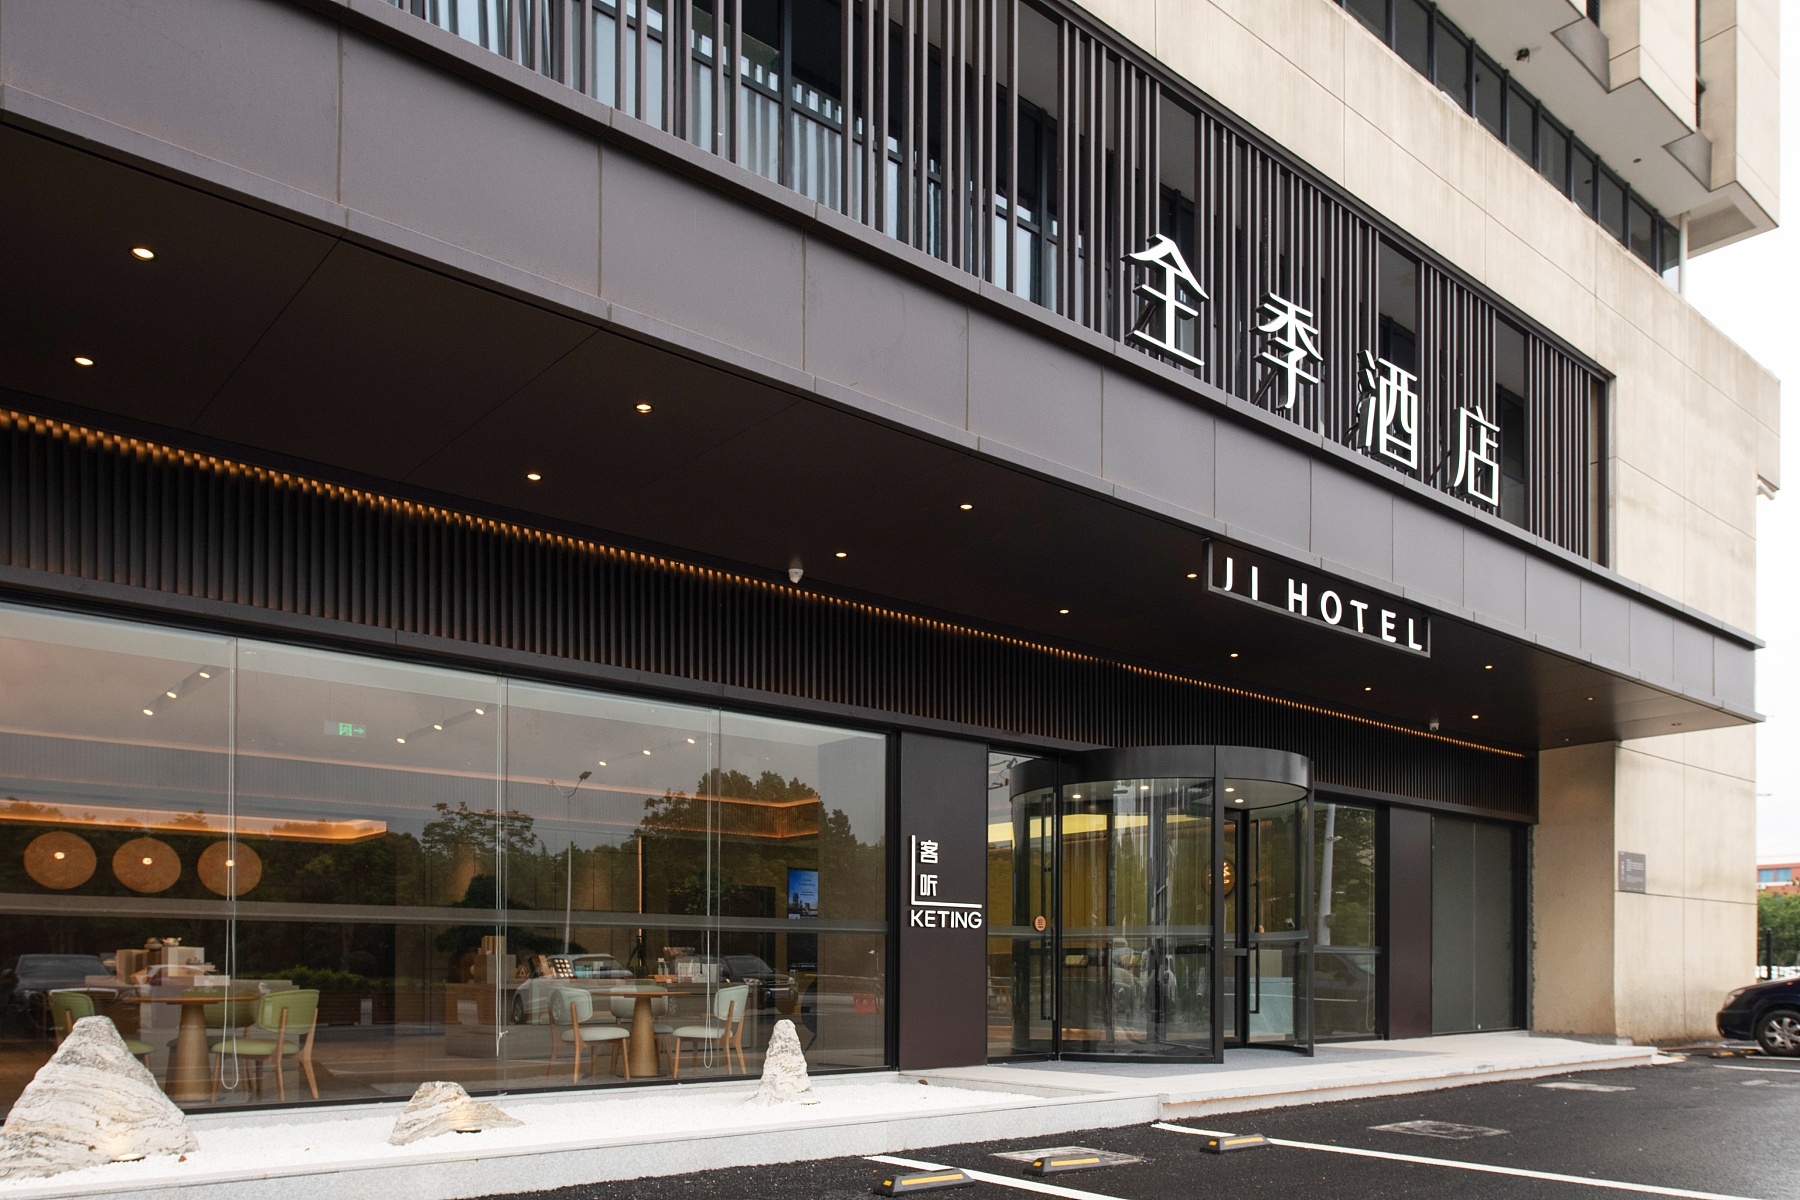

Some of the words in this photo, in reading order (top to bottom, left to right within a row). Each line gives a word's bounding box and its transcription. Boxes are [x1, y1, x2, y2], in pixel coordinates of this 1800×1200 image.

[1126, 233, 1500, 507] 全季酒店
[1223, 557, 1258, 601] JI
[1288, 578, 1423, 651] HOTEL
[920, 839, 939, 897] 客听
[910, 909, 983, 929] KETING
